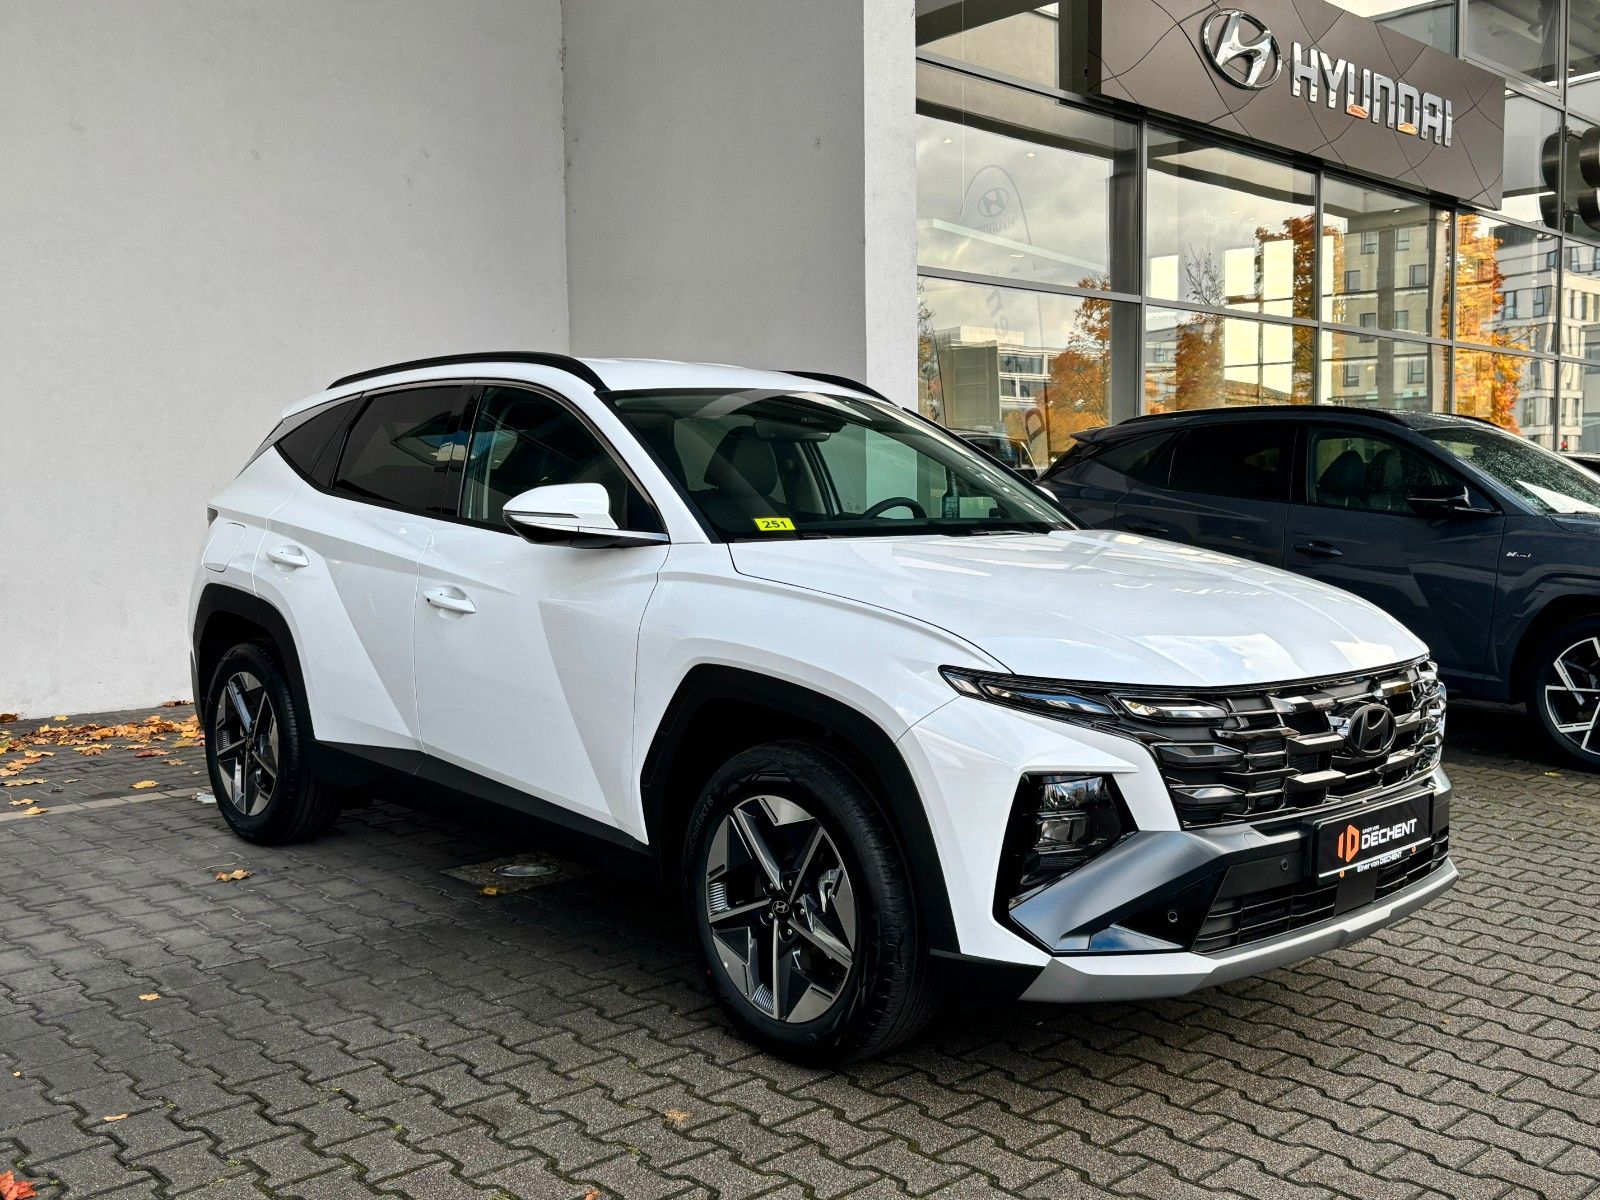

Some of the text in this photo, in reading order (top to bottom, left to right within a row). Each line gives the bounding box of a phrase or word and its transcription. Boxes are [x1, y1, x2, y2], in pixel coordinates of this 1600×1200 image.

[1291, 41, 1453, 147] HYUNDAI
[762, 520, 787, 529] 251
[1361, 818, 1417, 850] DECHENT
